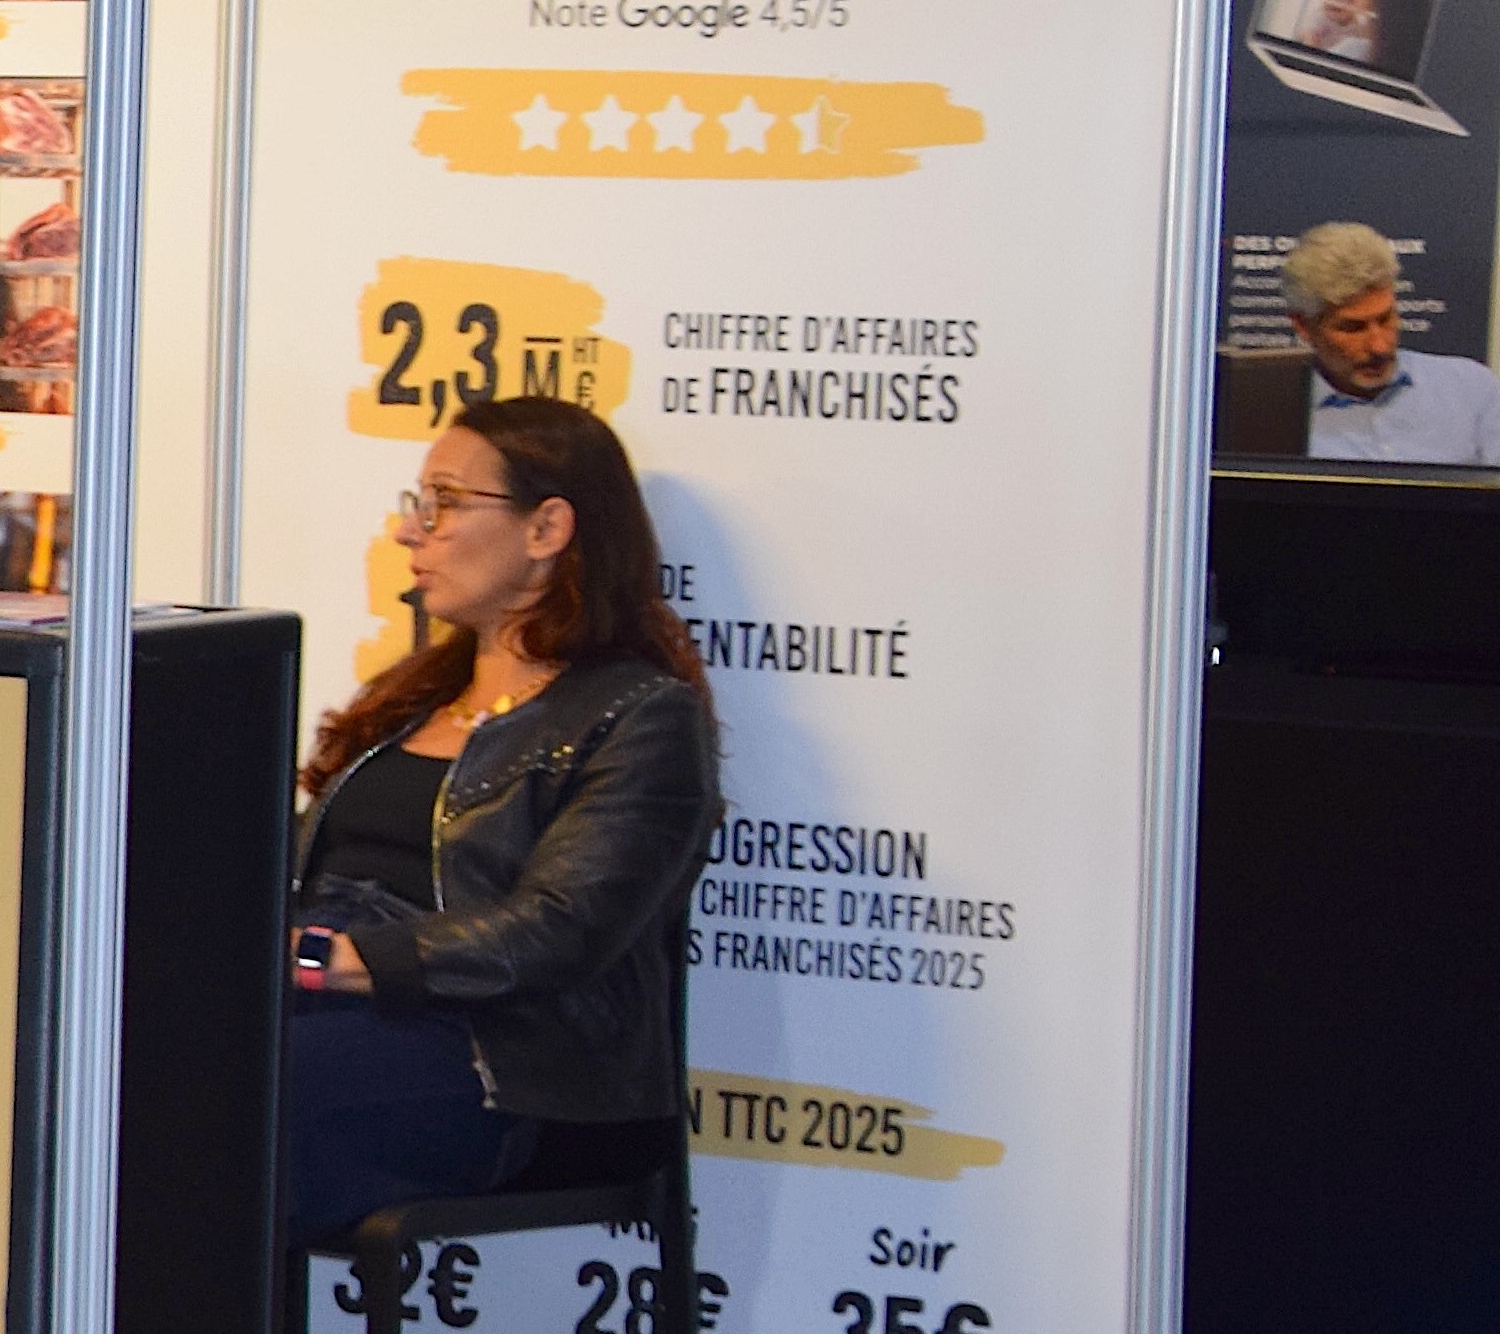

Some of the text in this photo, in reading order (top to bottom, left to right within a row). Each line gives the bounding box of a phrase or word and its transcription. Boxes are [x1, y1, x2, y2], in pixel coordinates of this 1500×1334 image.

[573, 336, 599, 364] HT
[665, 311, 980, 359] CHIFFRE D'AFFAIRES
[377, 299, 501, 429] 2,3
[663, 367, 961, 425] DE FRANCHISÉS
[700, 878, 1017, 942] CHIFFRE D'AFFAIRES
[714, 933, 902, 986] FRANCHISÉS
[911, 947, 987, 990] 2025
[719, 1089, 787, 1145] TTC
[802, 1099, 905, 1157] 2025
[869, 1226, 957, 1275] Soir
